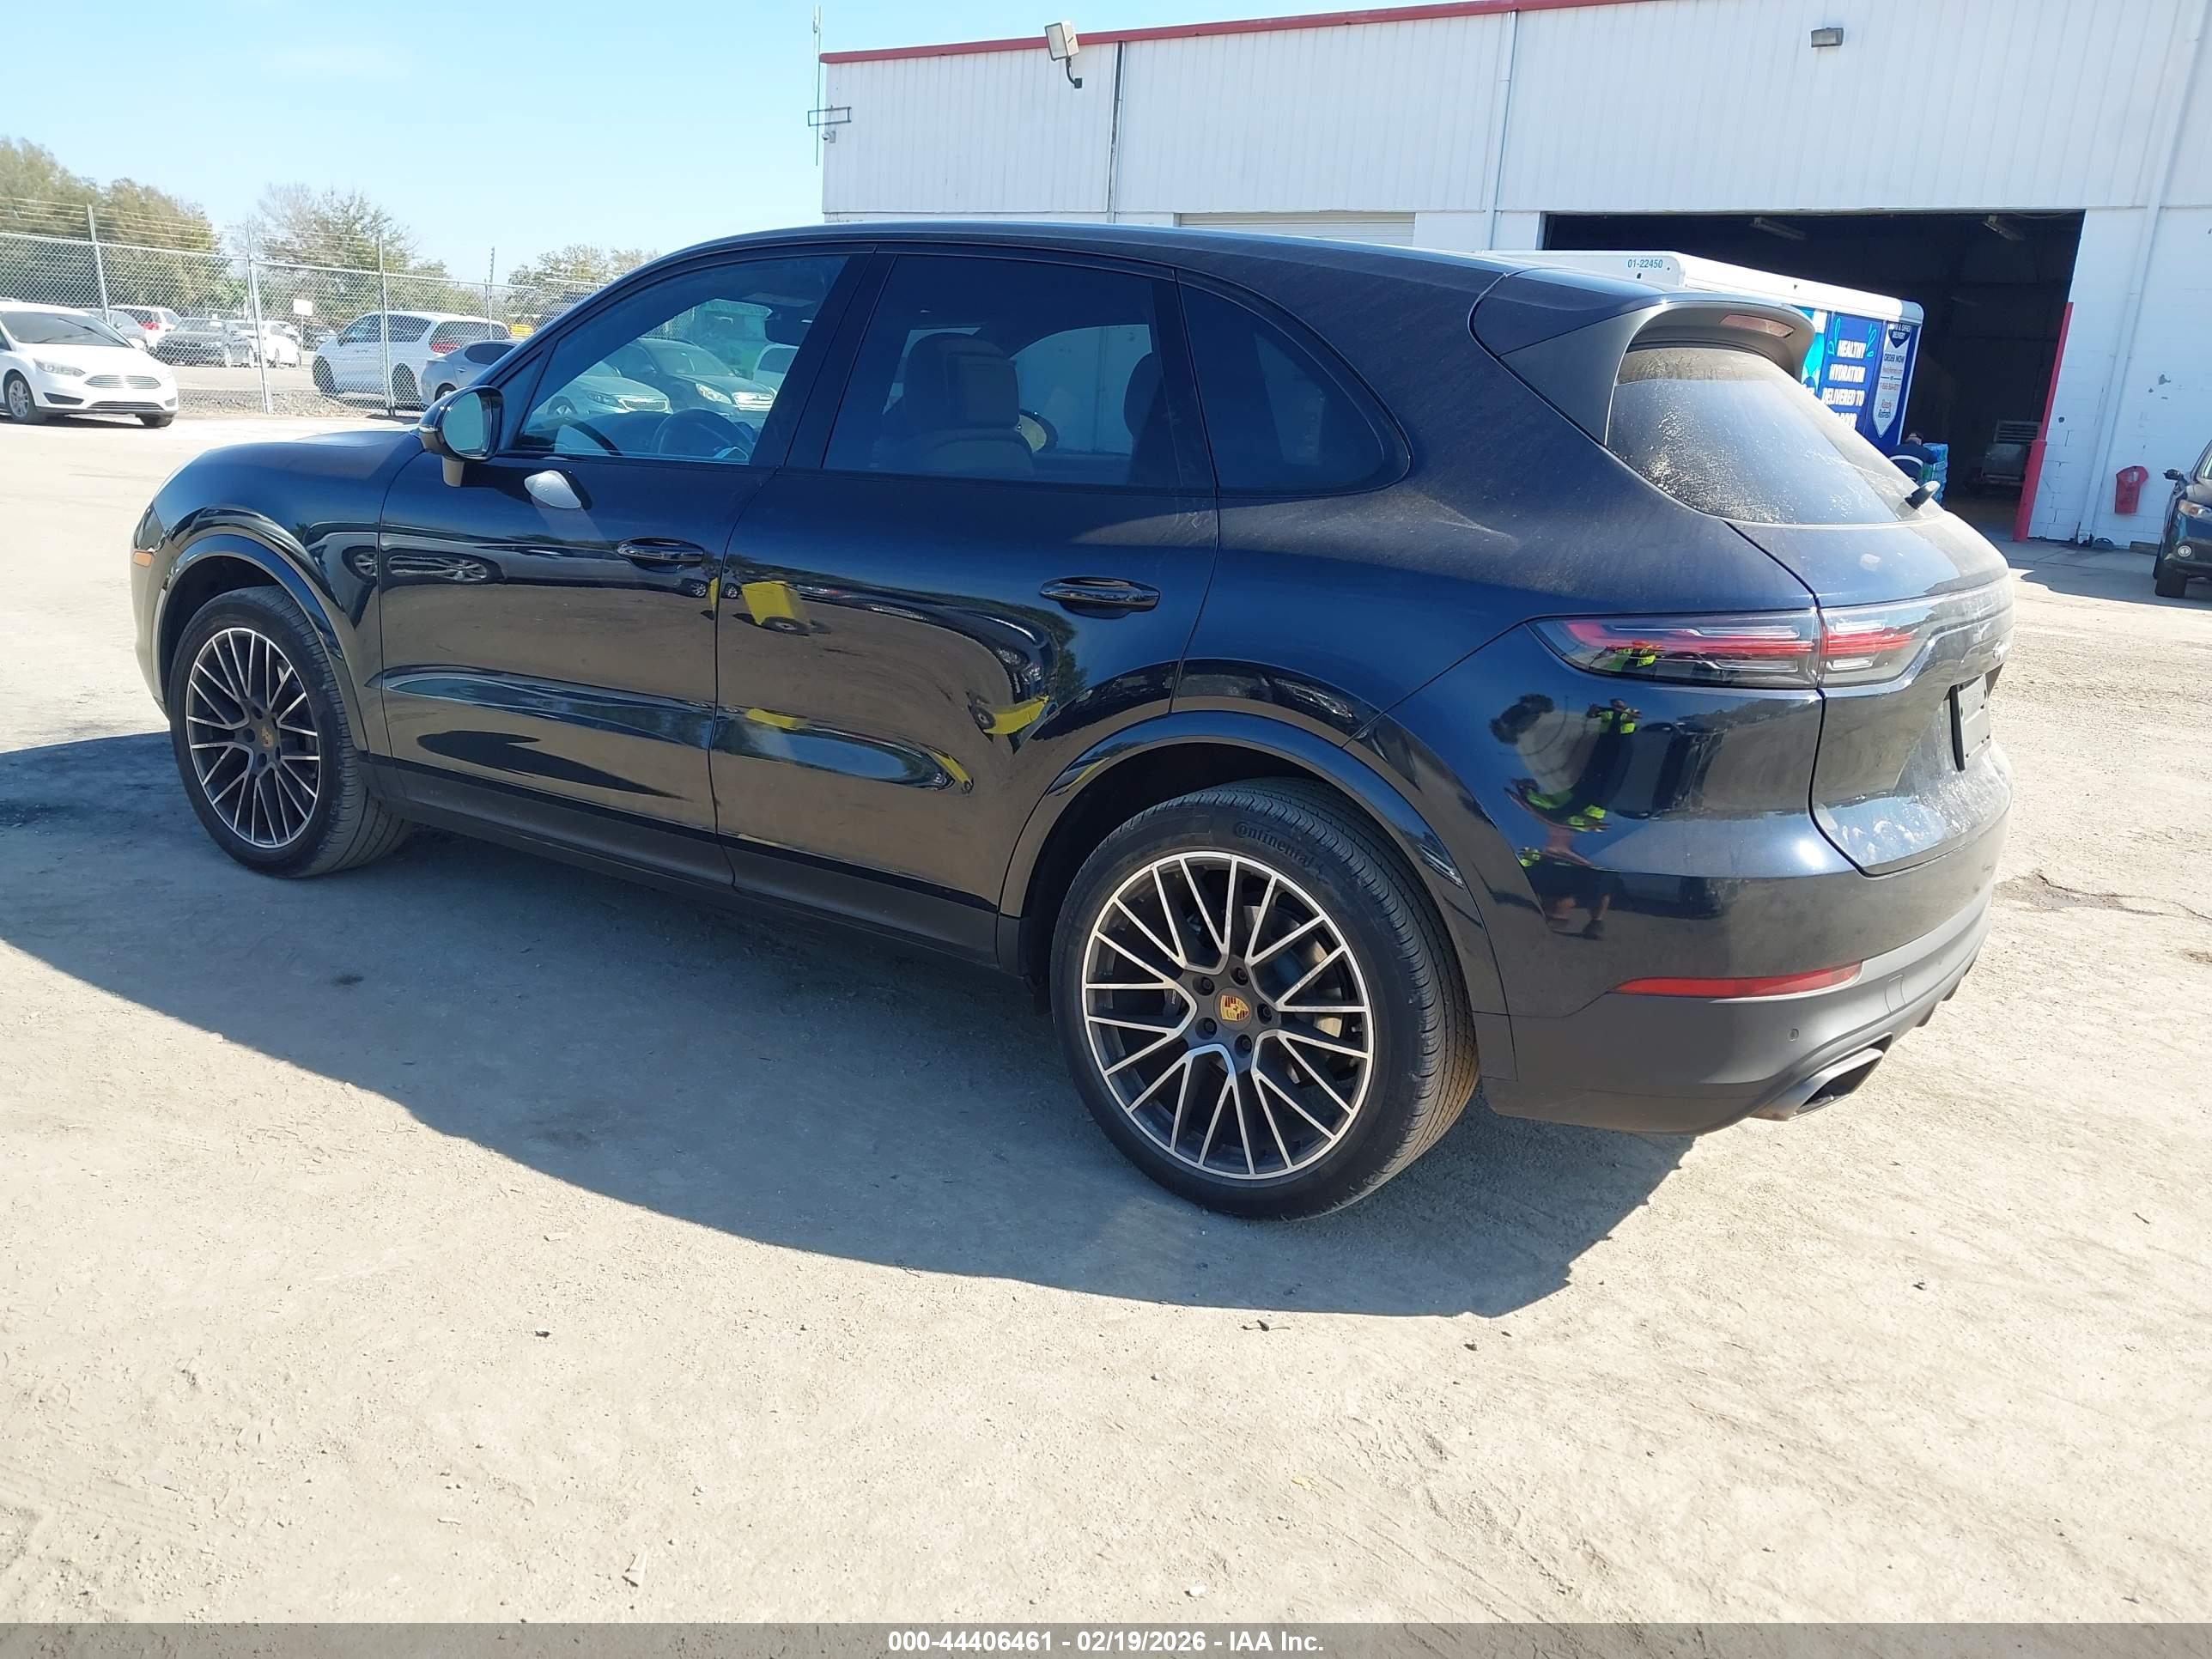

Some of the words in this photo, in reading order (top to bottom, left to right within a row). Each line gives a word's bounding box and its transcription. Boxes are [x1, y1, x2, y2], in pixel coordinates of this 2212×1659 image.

[1627, 258, 1663, 268] 01-22450
[1837, 340, 1867, 358] HEALTHY
[1884, 353, 1896, 362] ORDER
[1896, 355, 1905, 363] NOW
[1828, 364, 1866, 383] HYDRATION
[1822, 387, 1856, 405] DELIVERED
[1854, 390, 1865, 407] TO
[1234, 821, 1315, 868] Continental
